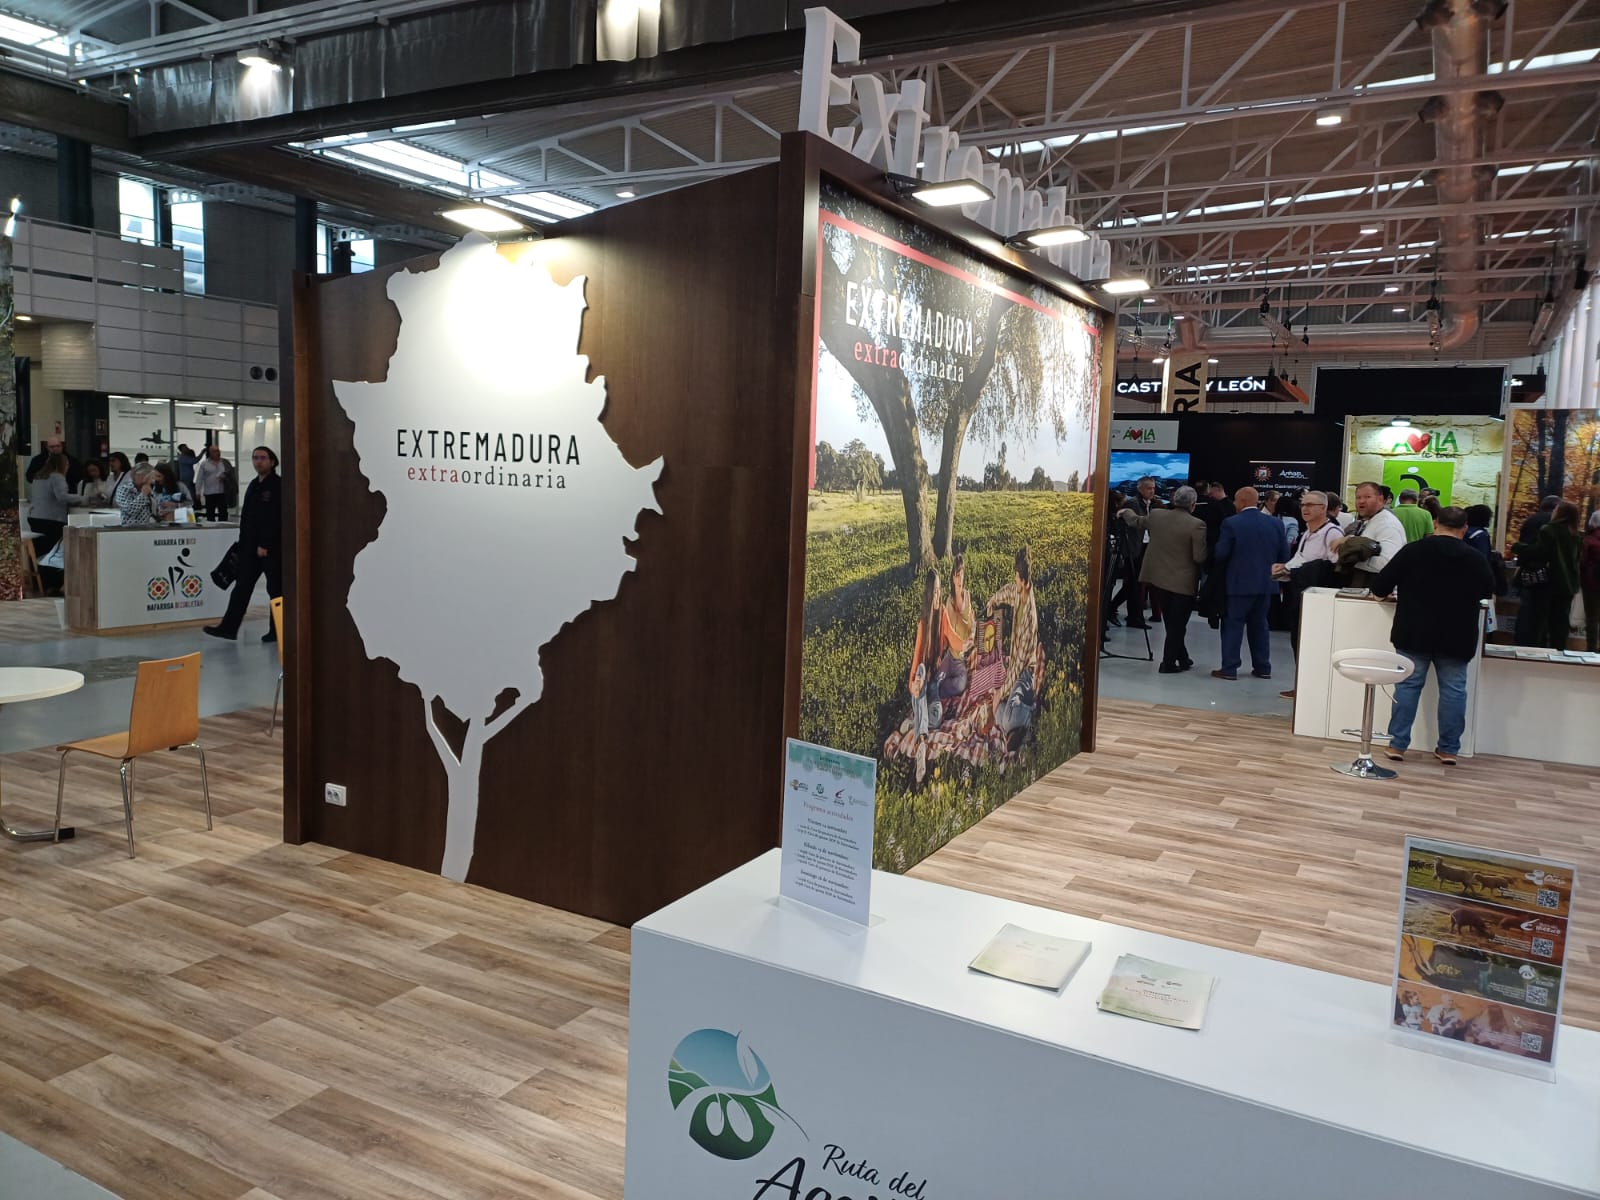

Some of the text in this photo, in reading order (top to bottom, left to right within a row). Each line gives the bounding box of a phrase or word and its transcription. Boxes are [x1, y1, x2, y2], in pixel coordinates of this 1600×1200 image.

[845, 281, 973, 357] EXTREMADURA
[854, 337, 964, 383] extraordinaria
[1117, 381, 1162, 393] CAST
[1217, 375, 1266, 392] LEÓN
[397, 429, 581, 466] EXTREMADURA
[407, 465, 567, 489] extraordinaria
[822, 1143, 880, 1186] Ruta
[888, 1171, 928, 1200] del
